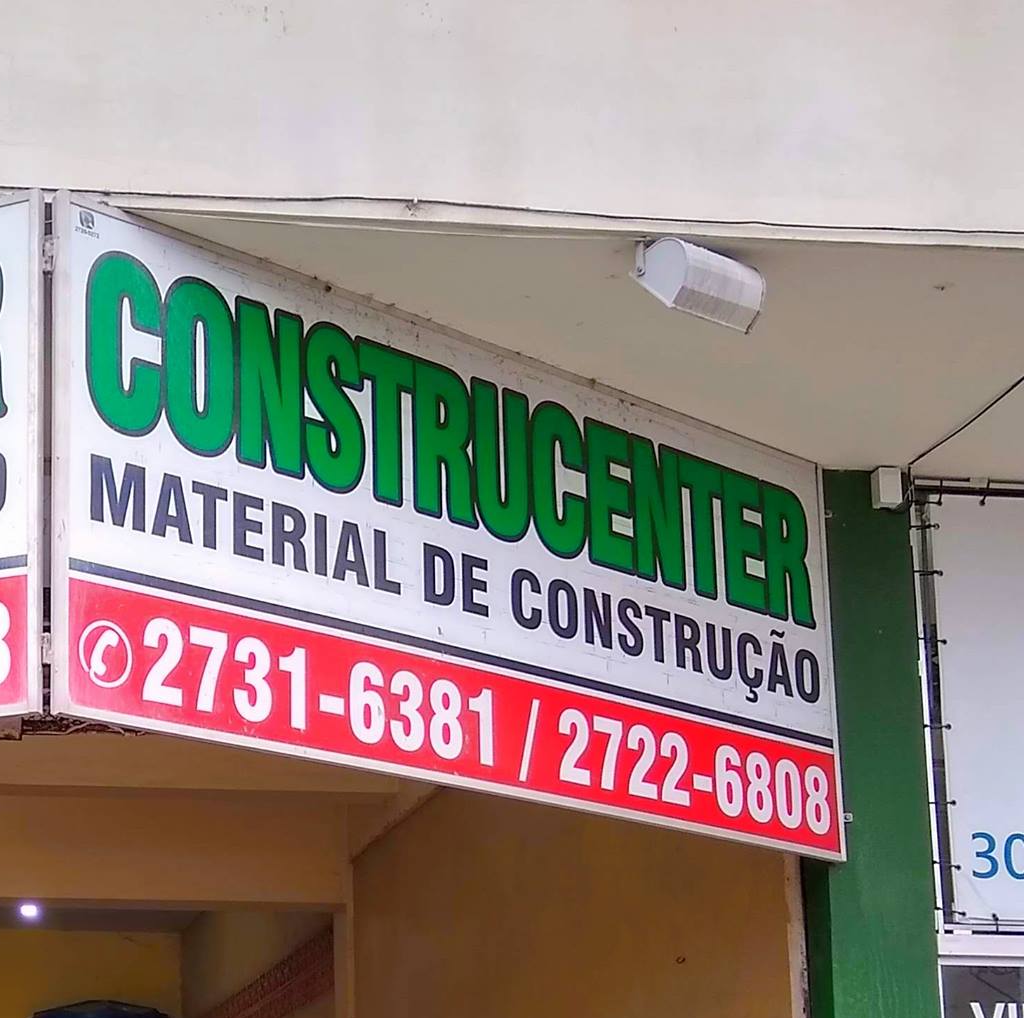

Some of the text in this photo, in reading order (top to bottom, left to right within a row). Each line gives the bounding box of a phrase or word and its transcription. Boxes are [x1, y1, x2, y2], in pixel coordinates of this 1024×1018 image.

[86, 250, 817, 630] CONSTRUCENTER
[89, 453, 820, 704] MATERIAL DE CONSTRUÇÃO
[141, 617, 832, 836] 2731-6381 / 2722-6808
